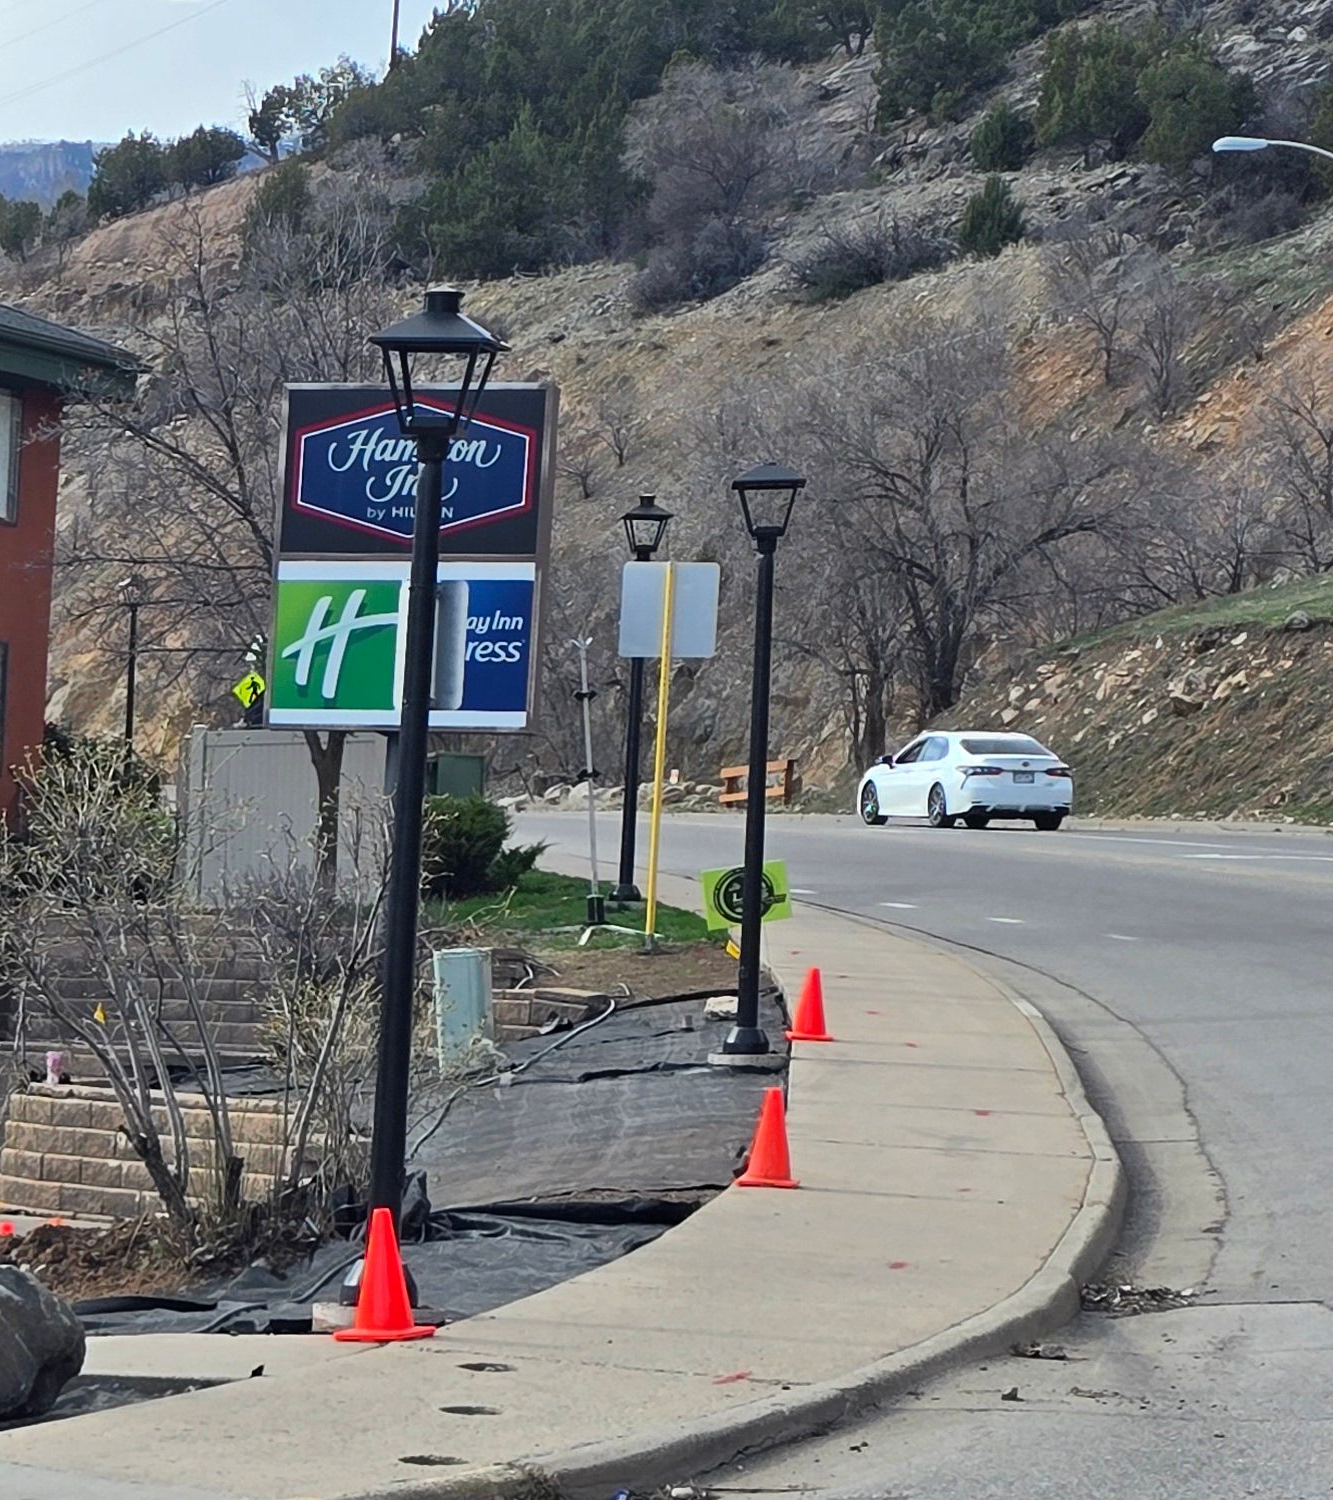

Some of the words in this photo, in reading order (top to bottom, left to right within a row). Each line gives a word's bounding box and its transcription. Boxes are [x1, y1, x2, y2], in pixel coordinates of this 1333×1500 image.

[328, 427, 502, 472] Hamon
[365, 465, 458, 502] In
[366, 506, 386, 521] by
[391, 506, 454, 519] HILN
[492, 609, 524, 631] Inn
